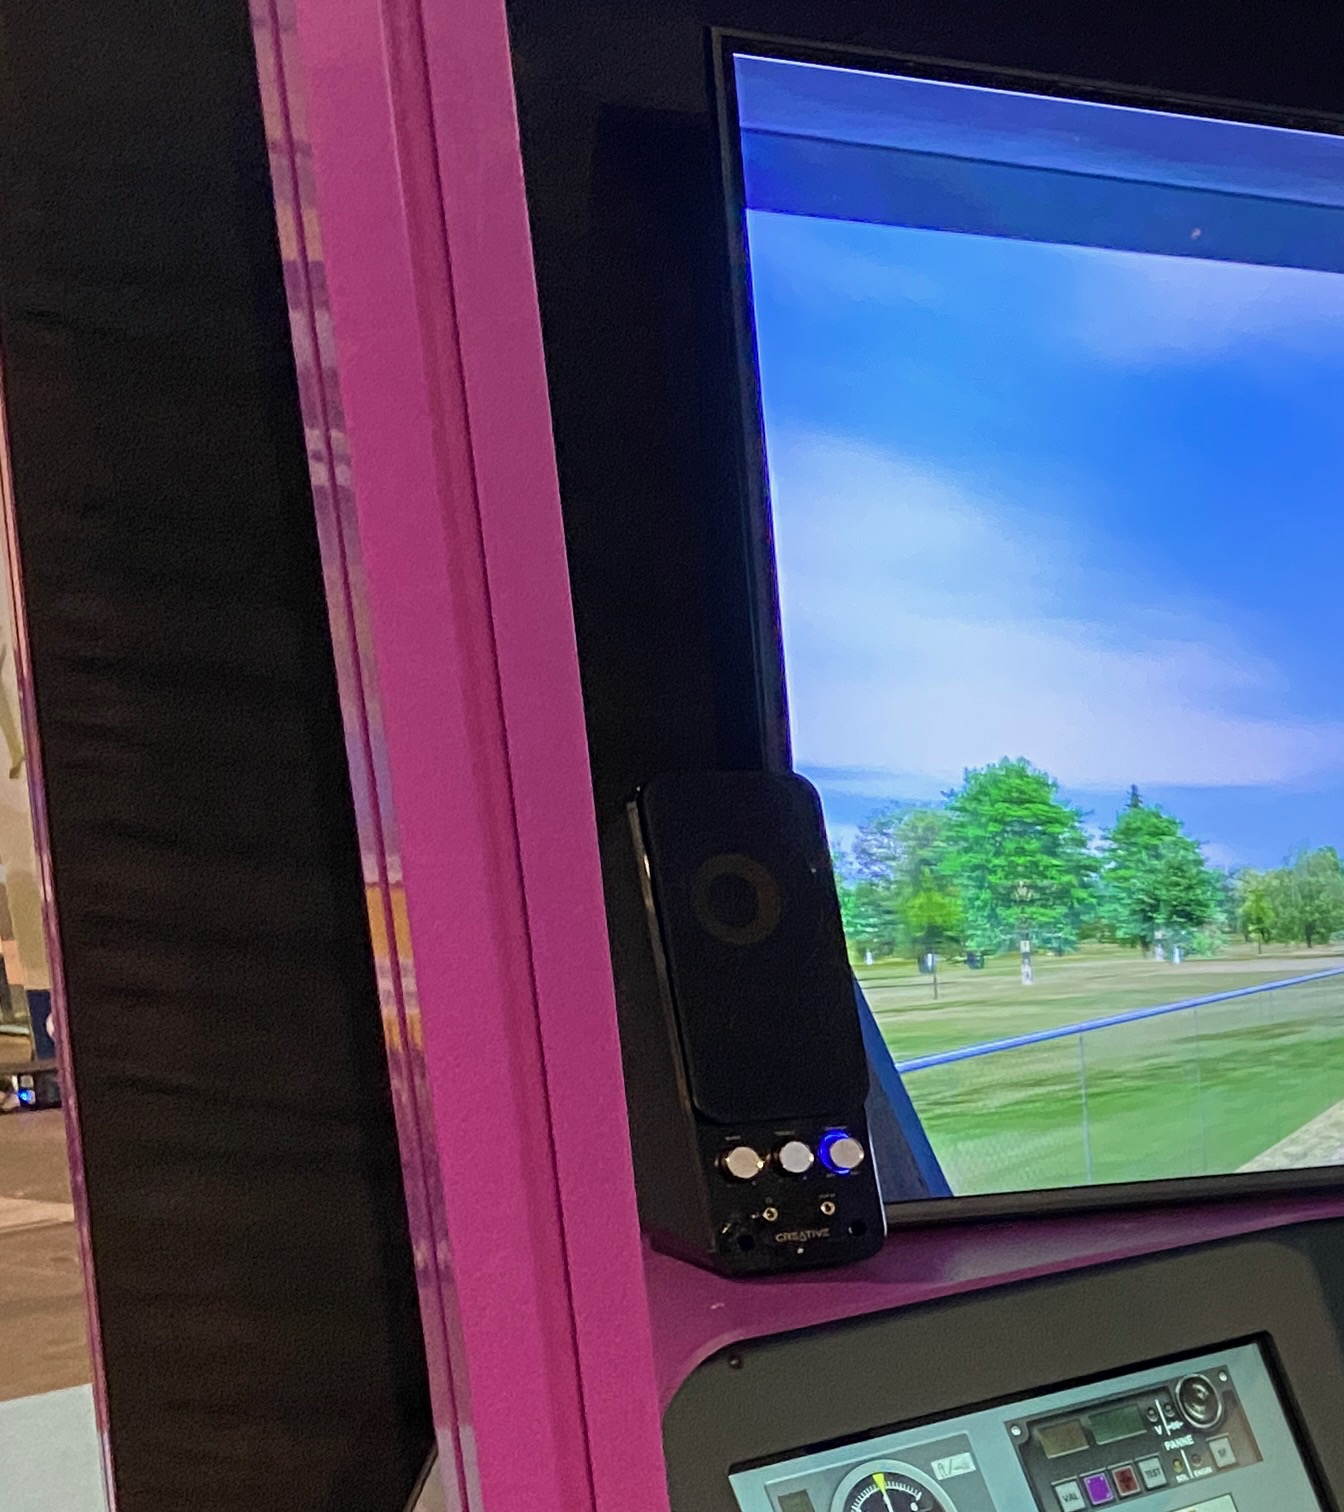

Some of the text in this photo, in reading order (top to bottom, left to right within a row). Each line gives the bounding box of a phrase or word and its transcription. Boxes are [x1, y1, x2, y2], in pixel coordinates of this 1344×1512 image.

[776, 1228, 830, 1242] CREATIVE
[1164, 1434, 1194, 1450] PANNE
[1145, 1468, 1160, 1479] TEST
[1062, 1492, 1080, 1503] VAL
